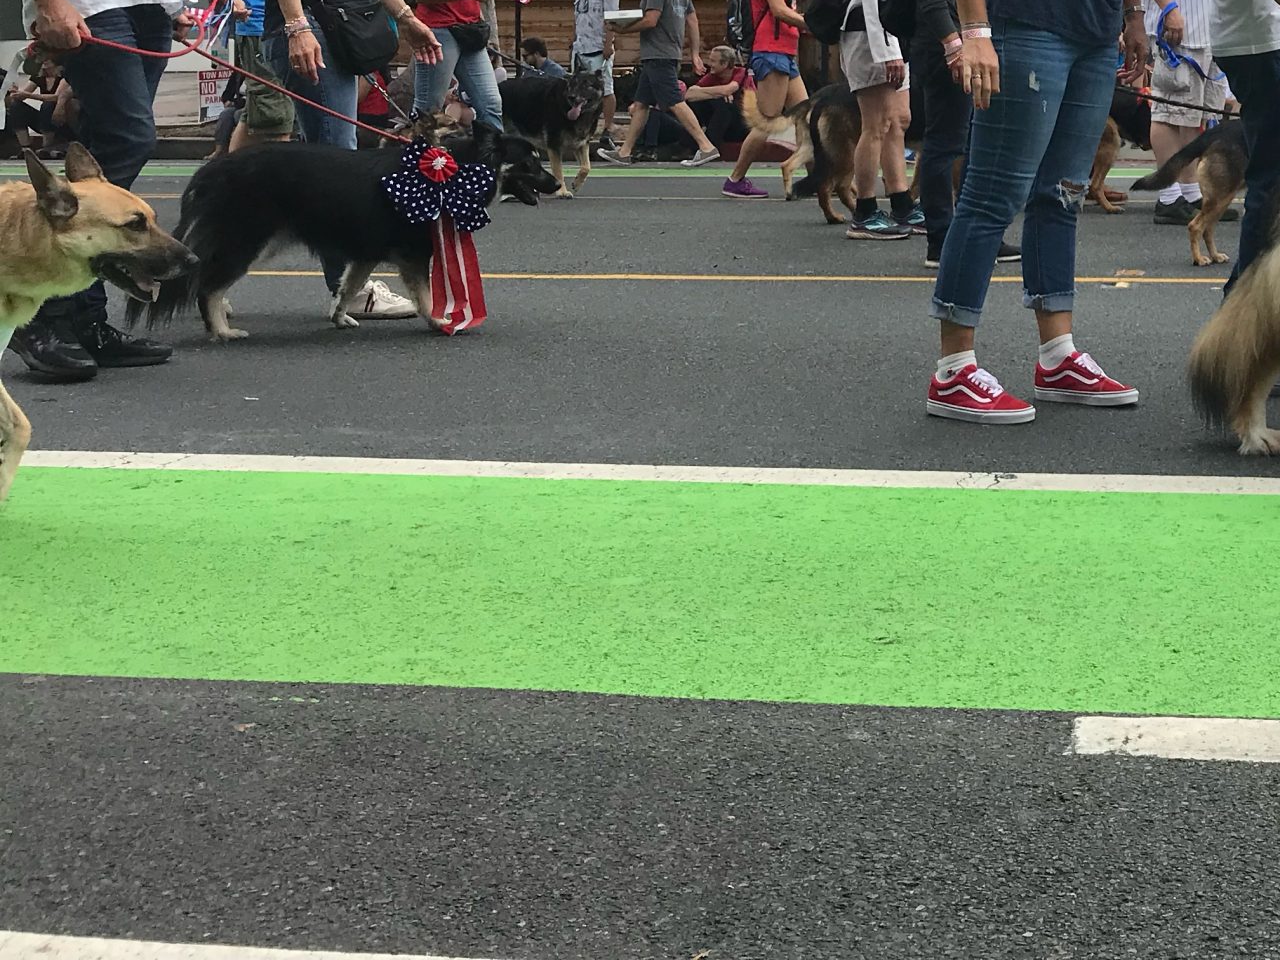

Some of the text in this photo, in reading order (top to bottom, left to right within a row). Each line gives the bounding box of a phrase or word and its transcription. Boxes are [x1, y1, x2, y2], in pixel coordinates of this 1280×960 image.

[202, 70, 234, 79] TOW AWA
[201, 82, 215, 95] NO
